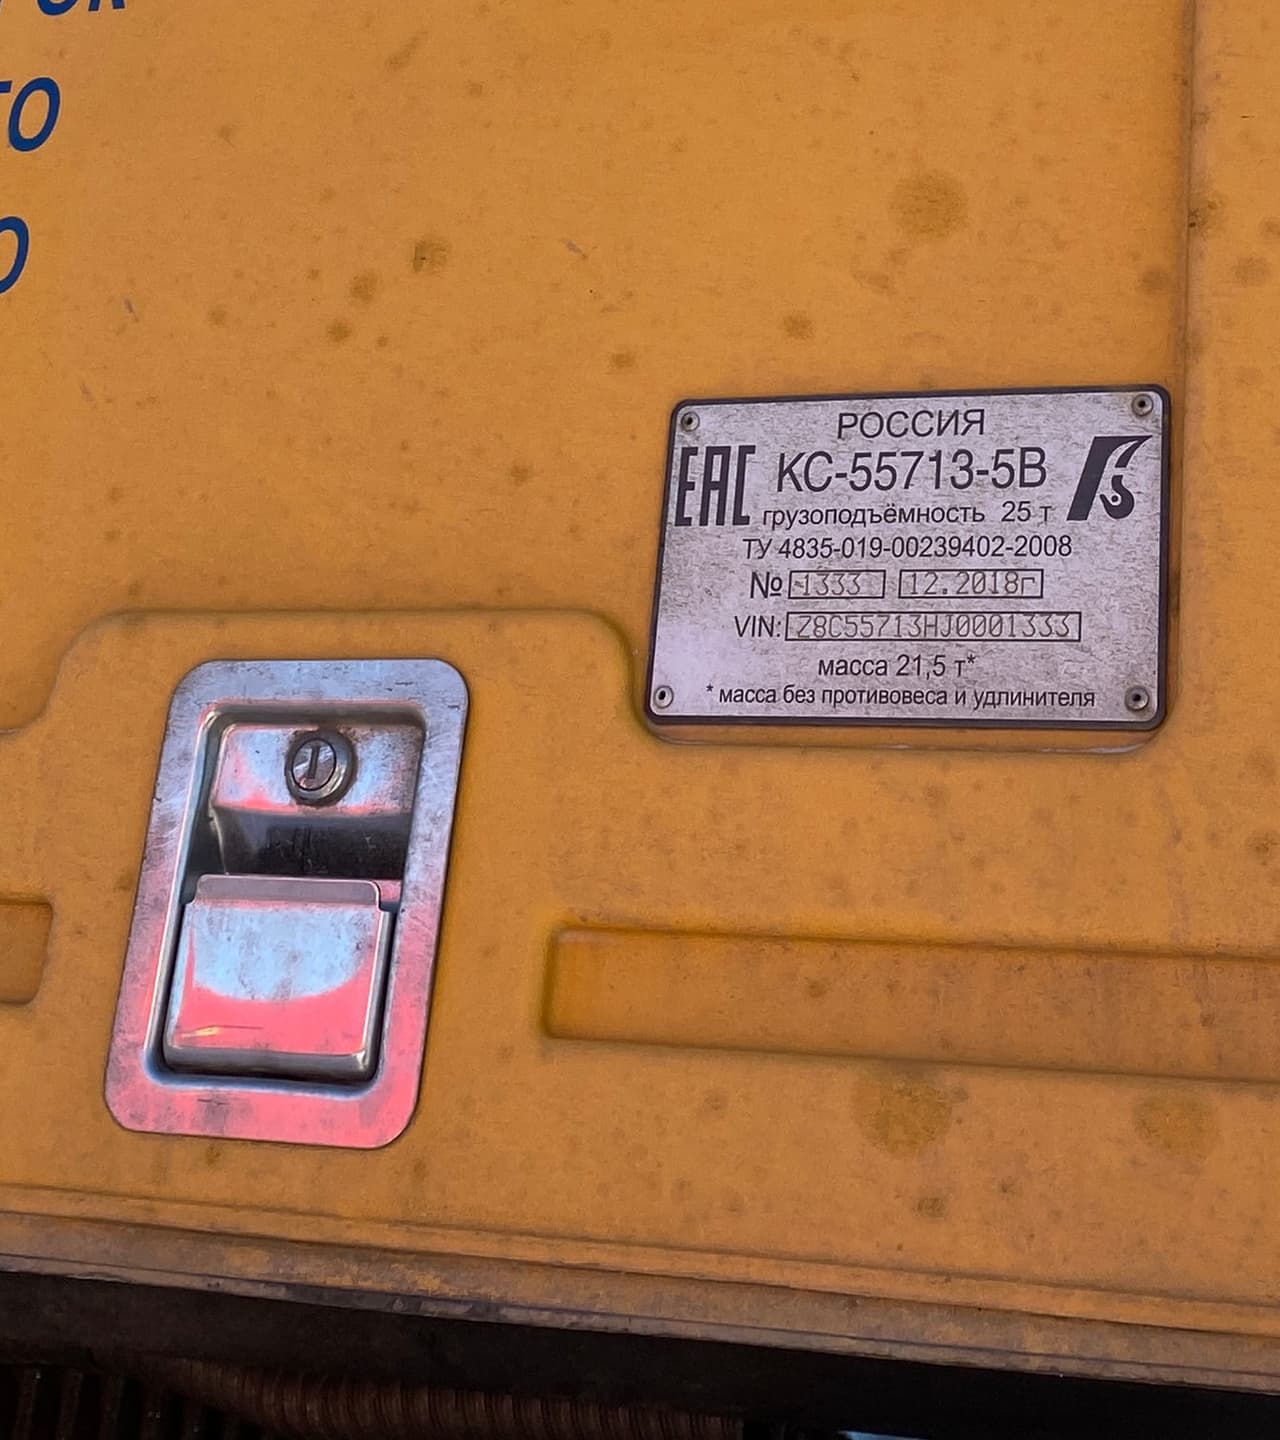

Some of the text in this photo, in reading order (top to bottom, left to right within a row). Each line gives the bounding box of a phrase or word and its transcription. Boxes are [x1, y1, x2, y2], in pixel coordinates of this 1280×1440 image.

[837, 408, 985, 440] РОССИЯ
[776, 446, 1048, 493] КС-55713-5В
[762, 500, 1053, 531] грузоподъёмность 25 т
[742, 535, 1073, 560] ТУ 4835-019-00239402-2008
[734, 615, 782, 639] VIN:
[817, 658, 889, 677] масса
[895, 654, 947, 680] 21,5
[719, 687, 777, 705] масса
[783, 684, 816, 705] без
[821, 687, 948, 709] противовеса
[954, 687, 967, 706] и
[973, 688, 1095, 710] удлинителя
